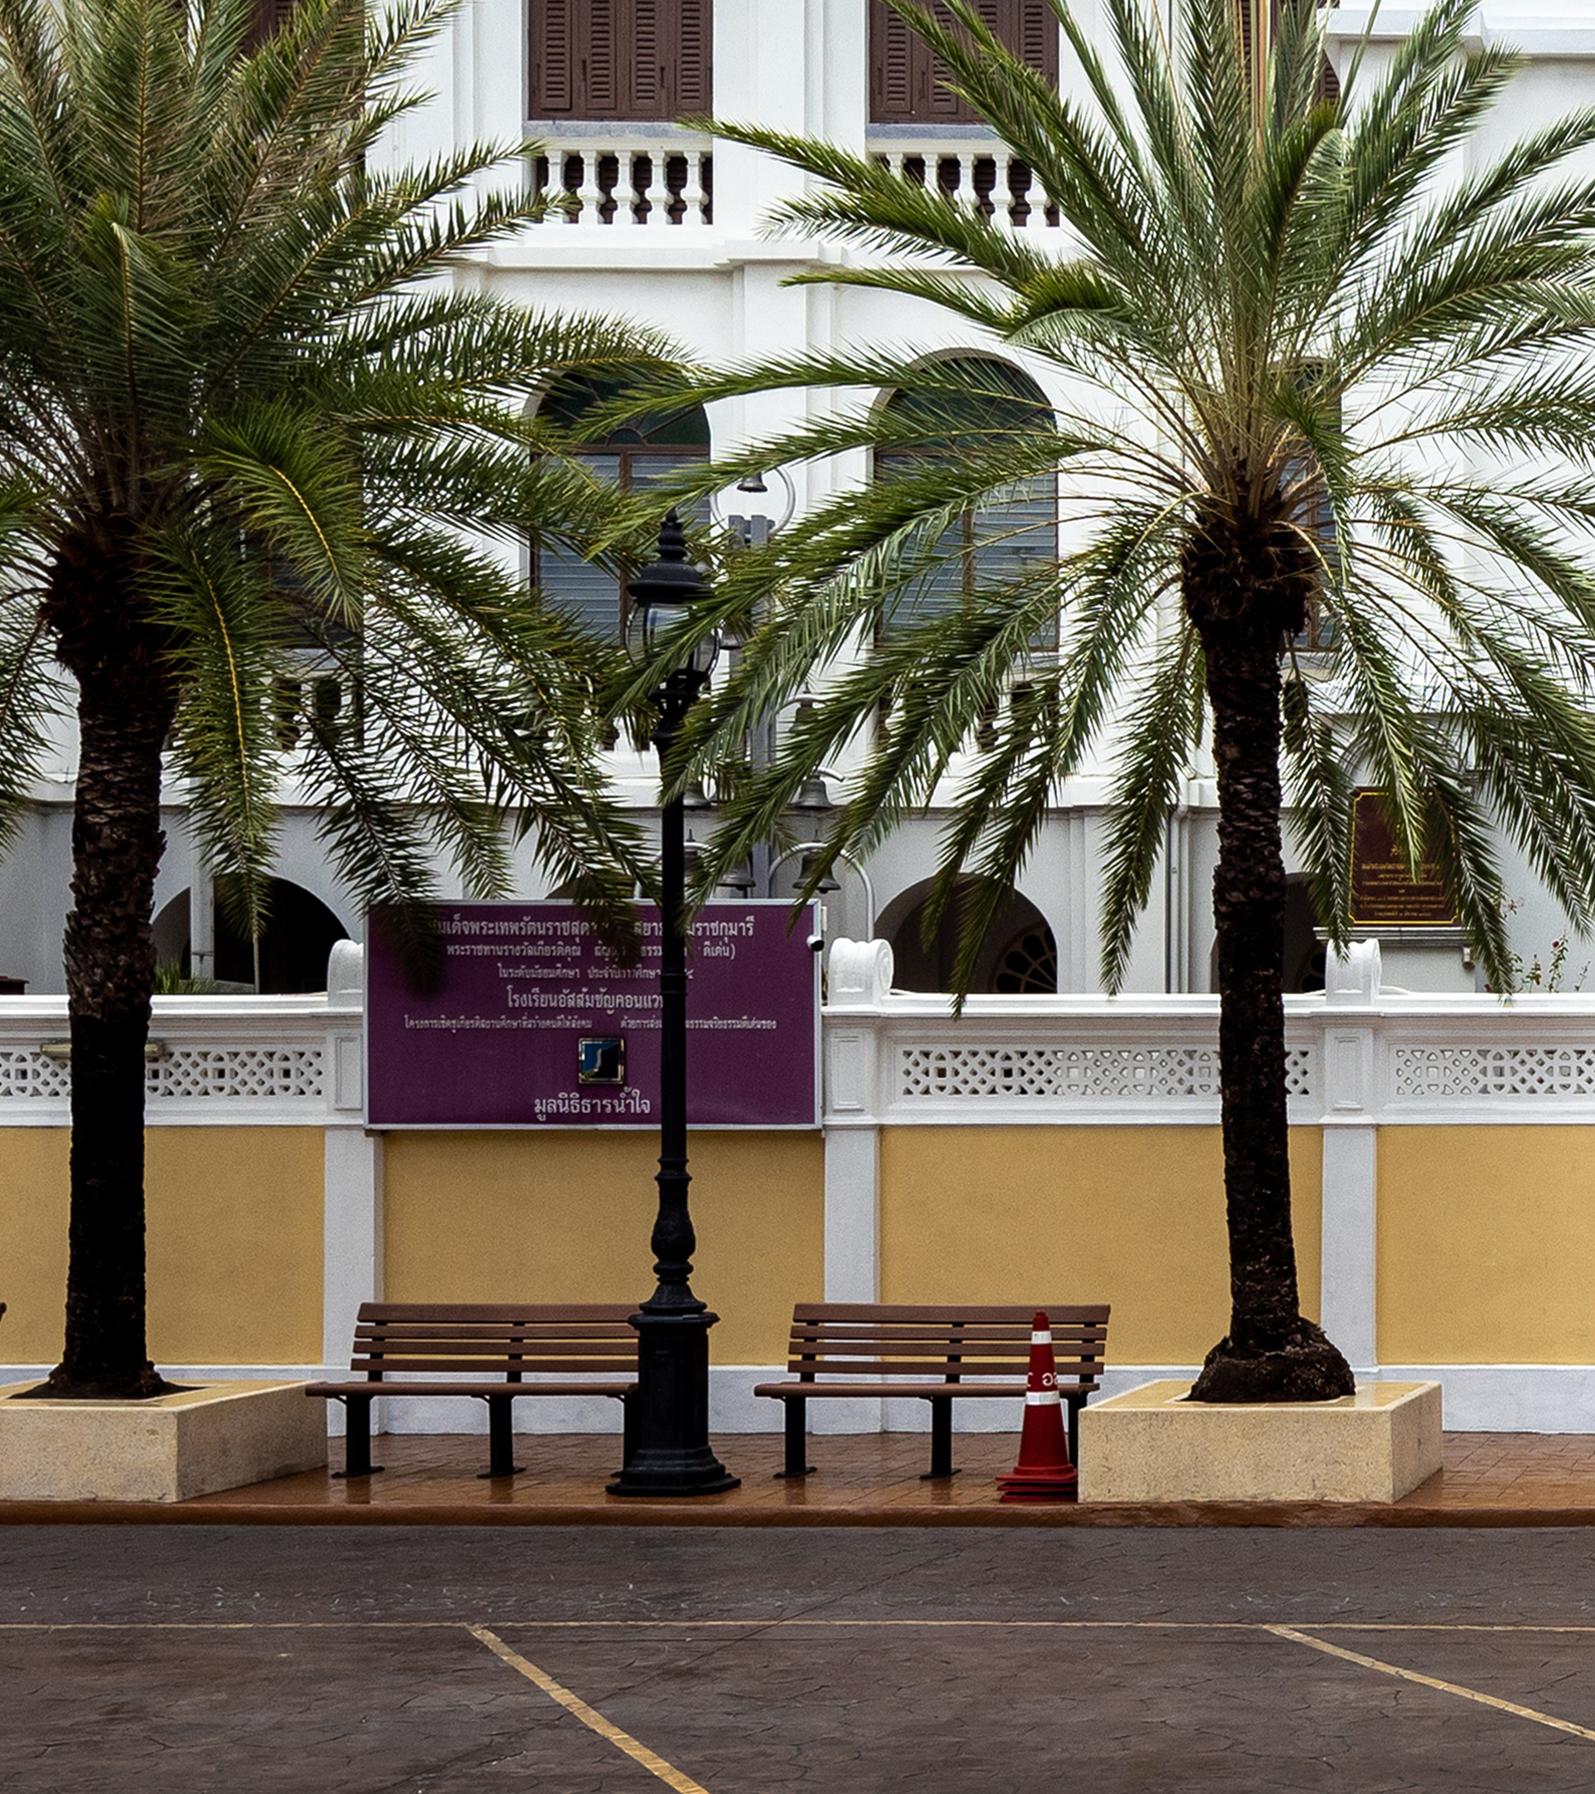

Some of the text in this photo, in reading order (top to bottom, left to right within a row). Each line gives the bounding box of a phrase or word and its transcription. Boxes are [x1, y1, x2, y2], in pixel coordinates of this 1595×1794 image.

[533, 1086, 651, 1122] มูลนิธิธารน้ำใจ
